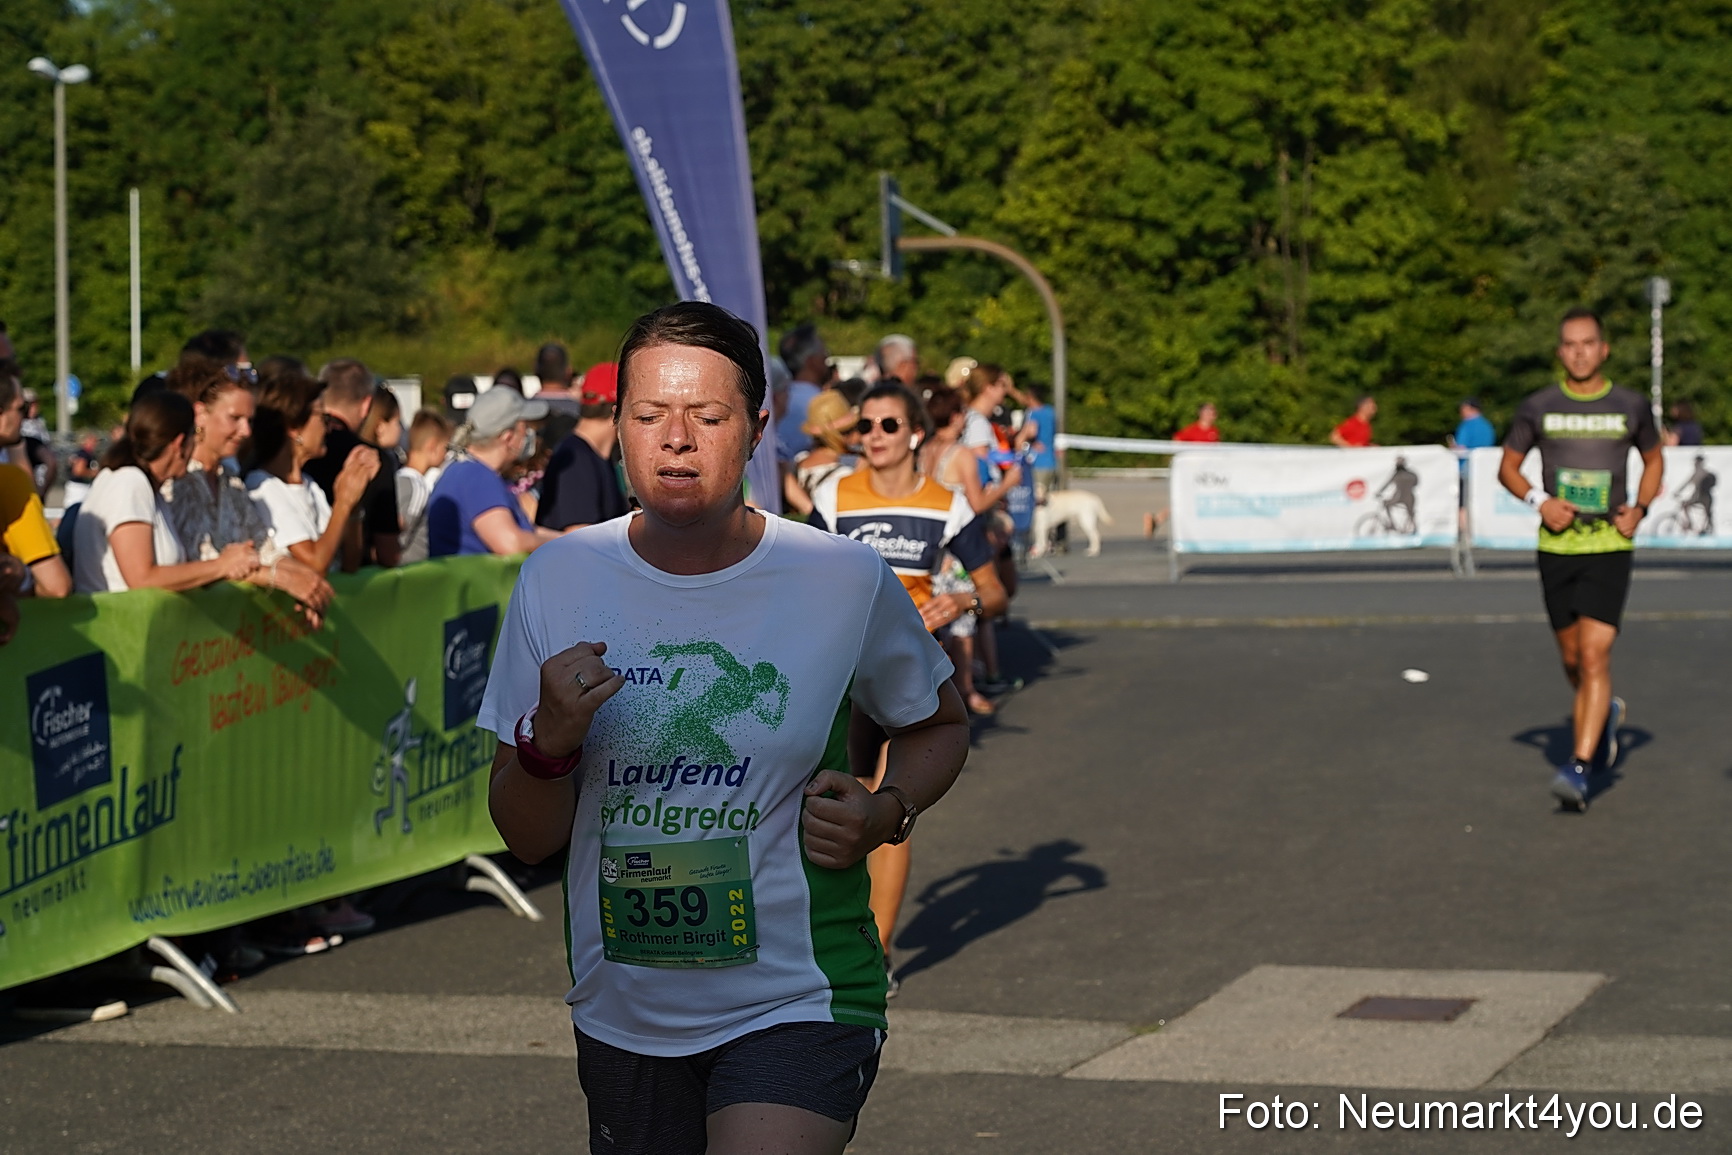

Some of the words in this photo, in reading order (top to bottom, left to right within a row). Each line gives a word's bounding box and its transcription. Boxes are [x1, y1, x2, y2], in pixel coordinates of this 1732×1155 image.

[43, 700, 95, 738] Fischer
[608, 755, 752, 792] Laufend
[8, 744, 184, 889] firmenlauf
[600, 795, 760, 836] erfolgreich
[620, 865, 672, 880] Firmenlauf
[640, 874, 672, 884] neumarkt
[12, 869, 88, 922] neumarkt
[624, 885, 709, 928] 359
[602, 896, 617, 939] RUN
[728, 887, 748, 946] 2022
[619, 929, 680, 946] Rothmer
[683, 929, 727, 947] Birgit
